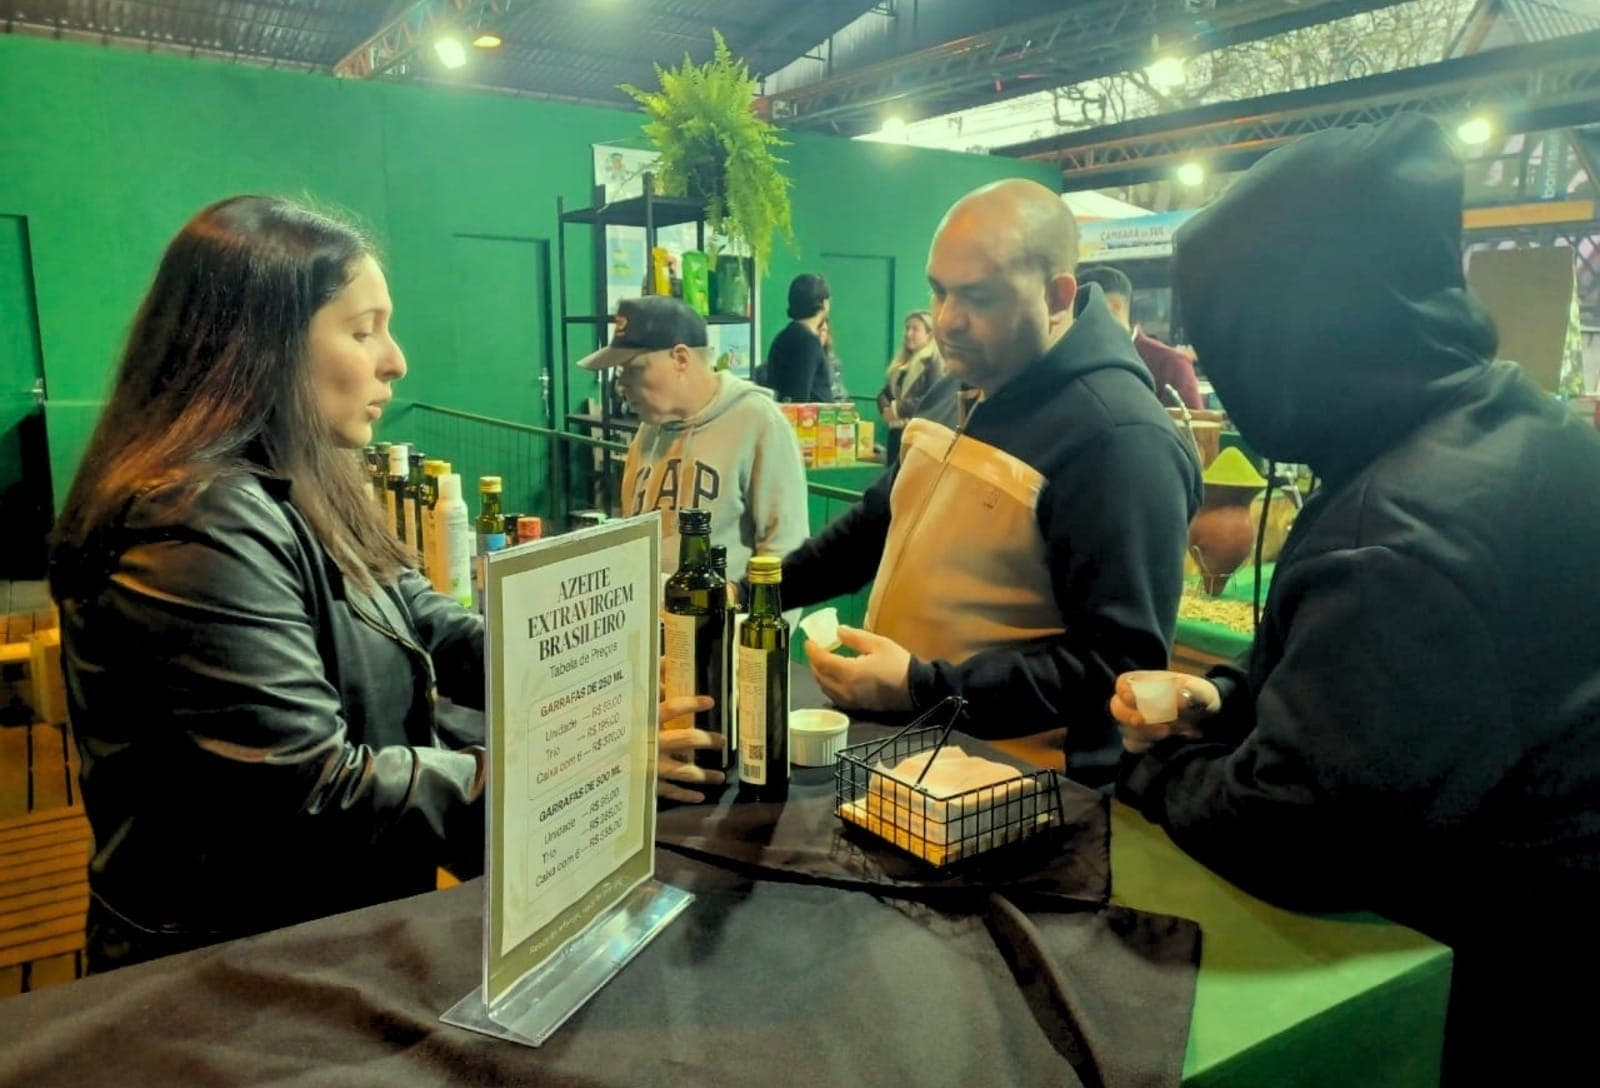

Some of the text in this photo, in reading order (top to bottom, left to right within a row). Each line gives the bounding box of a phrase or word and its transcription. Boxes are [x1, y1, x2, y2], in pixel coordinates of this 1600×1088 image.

[632, 458, 720, 516] GAP
[558, 567, 610, 603] AZEITE
[527, 583, 633, 639] EXTRAVIRGEM
[538, 610, 625, 661] BRASILEIRO
[549, 642, 618, 679] Tabela de Preços
[540, 669, 624, 717] GARRAFAS DE 250 ML
[545, 719, 577, 742] Unidade
[592, 704, 601, 718] R$
[545, 746, 560, 761] Trio
[587, 723, 597, 738] R$
[536, 765, 558, 785] Caixa
[559, 757, 575, 772] com
[592, 738, 601, 753] R$
[539, 765, 622, 822] GARRAFAS DE 500 ML
[542, 849, 557, 864] Trio
[590, 816, 599, 832] R$
[544, 819, 575, 844] Unidade
[590, 800, 599, 815] R$
[536, 866, 556, 887] Caixa
[557, 855, 574, 872] com
[589, 833, 599, 848] R$
